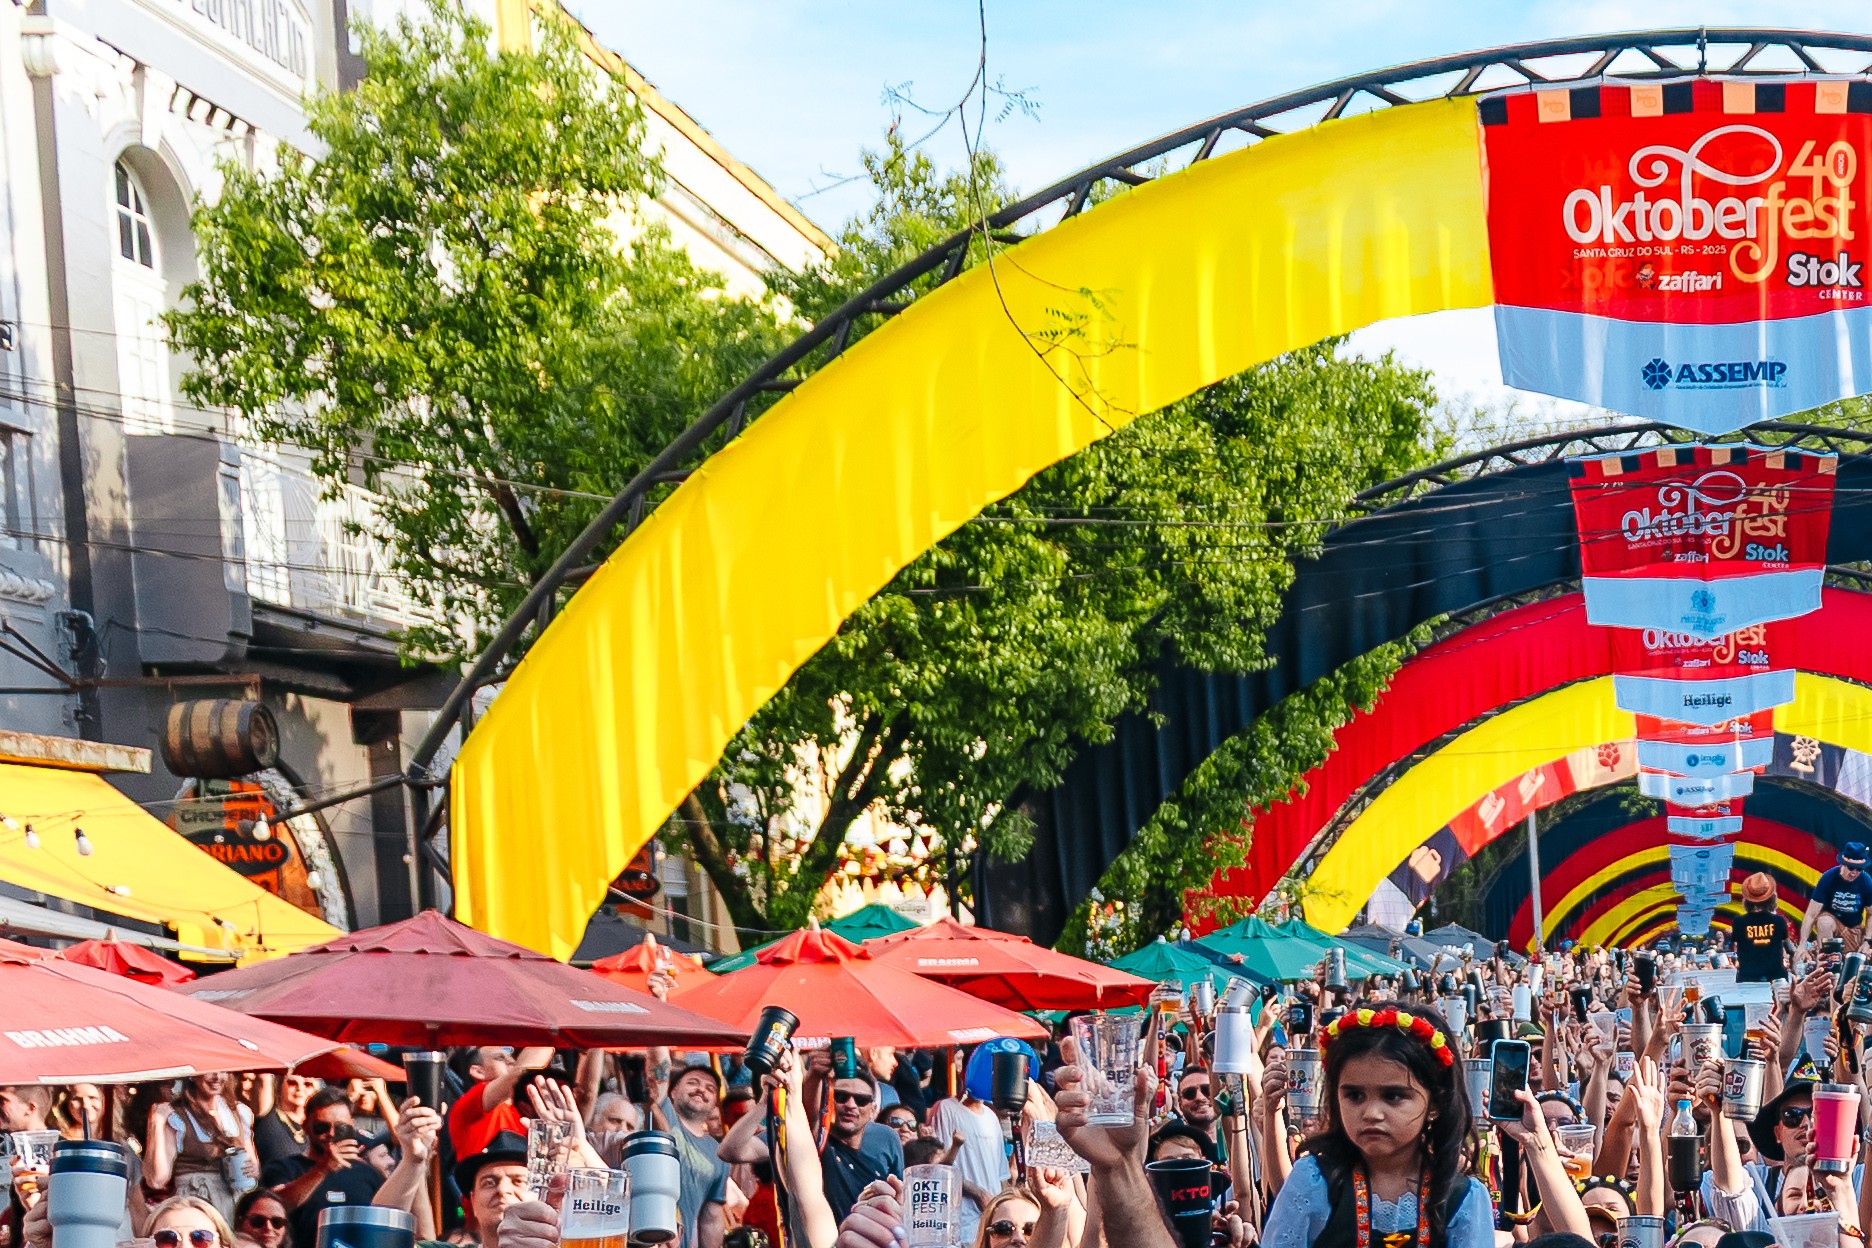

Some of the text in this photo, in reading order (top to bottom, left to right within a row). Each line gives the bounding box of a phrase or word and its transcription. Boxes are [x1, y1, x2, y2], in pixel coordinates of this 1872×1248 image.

[1787, 140, 1857, 200] 40
[1563, 125, 1856, 283] Oktoberfest
[1573, 244, 1727, 259] SANTA CRUZ DO SUL RS 2025
[1787, 252, 1862, 287] Stok
[1658, 270, 1722, 293] zaffari
[1818, 289, 1863, 301] CENTER
[1675, 361, 1788, 383] ASSEMP
[1621, 471, 1788, 559] Oktoberfest
[1745, 543, 1789, 561] Stok
[1683, 693, 1733, 709] Heilige
[1746, 924, 1775, 939] STAFF
[4, 1025, 130, 1048] BRAHMA
[913, 1181, 940, 1192] OKT
[1170, 1184, 1210, 1201] KTO
[912, 1192, 948, 1204] OBER
[573, 1199, 621, 1215] Heilige
[912, 1202, 947, 1216] FEST
[912, 1219, 948, 1230] Heilige
